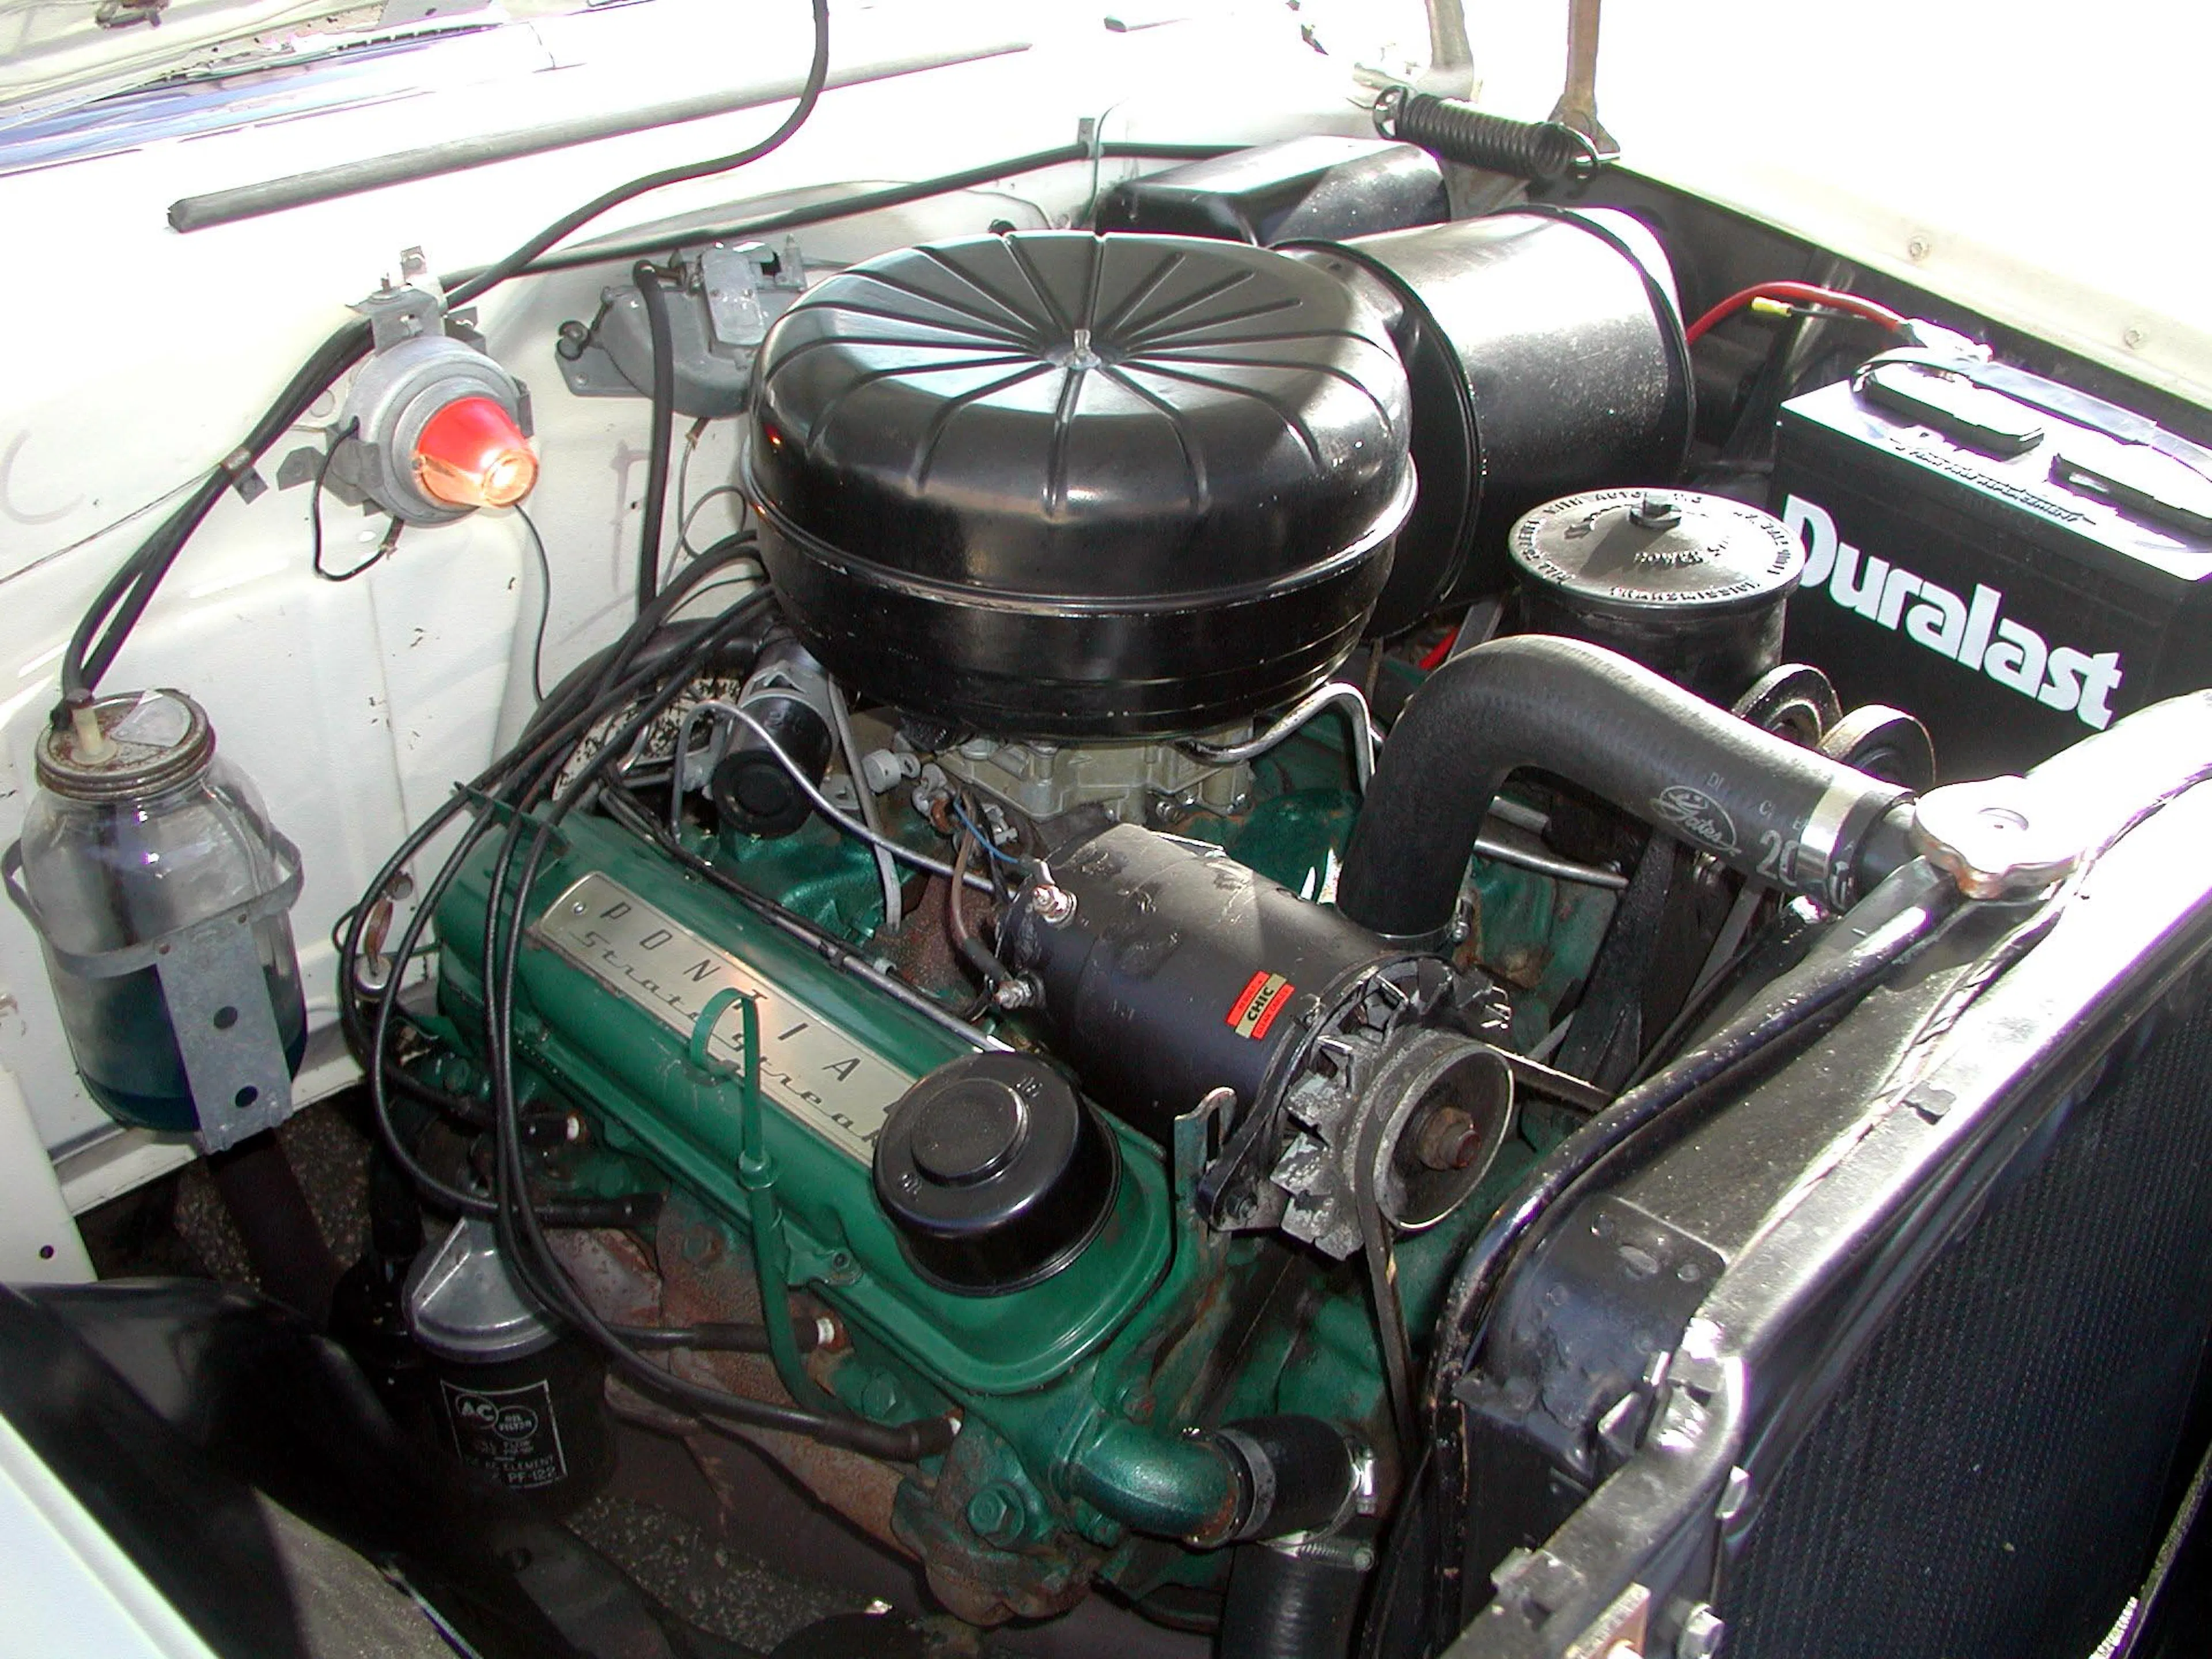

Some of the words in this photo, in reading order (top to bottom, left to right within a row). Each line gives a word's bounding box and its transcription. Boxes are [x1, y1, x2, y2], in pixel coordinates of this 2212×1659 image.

[1781, 493, 2123, 730] Duralast
[1650, 792, 1735, 850] Gates
[599, 901, 900, 1115] PONTIA
[1248, 987, 1274, 1021] CHIC
[460, 1400, 494, 1422] AC
